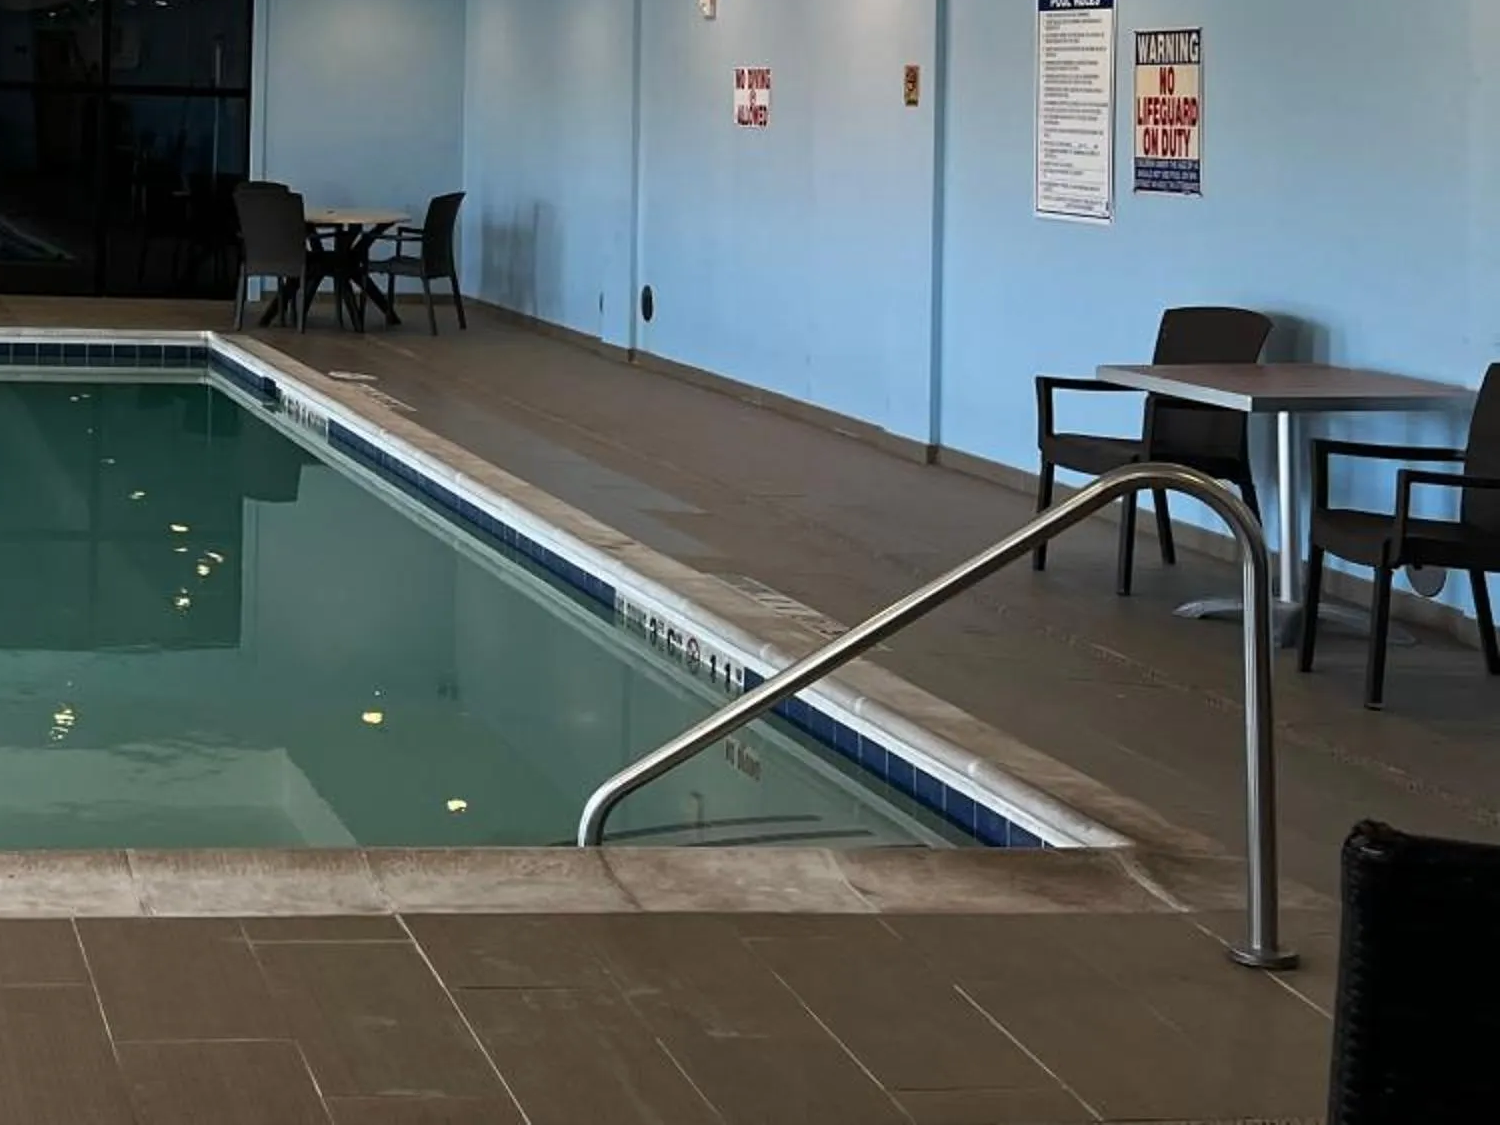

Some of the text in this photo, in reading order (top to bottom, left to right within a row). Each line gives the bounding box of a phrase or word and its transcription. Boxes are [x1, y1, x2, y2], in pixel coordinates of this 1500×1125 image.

[1137, 32, 1199, 64] WARNING
[735, 68, 745, 89] NO
[1160, 66, 1175, 95] NO
[1137, 96, 1198, 127] LIFEGUARD
[1143, 128, 1191, 157] ON DUTY
